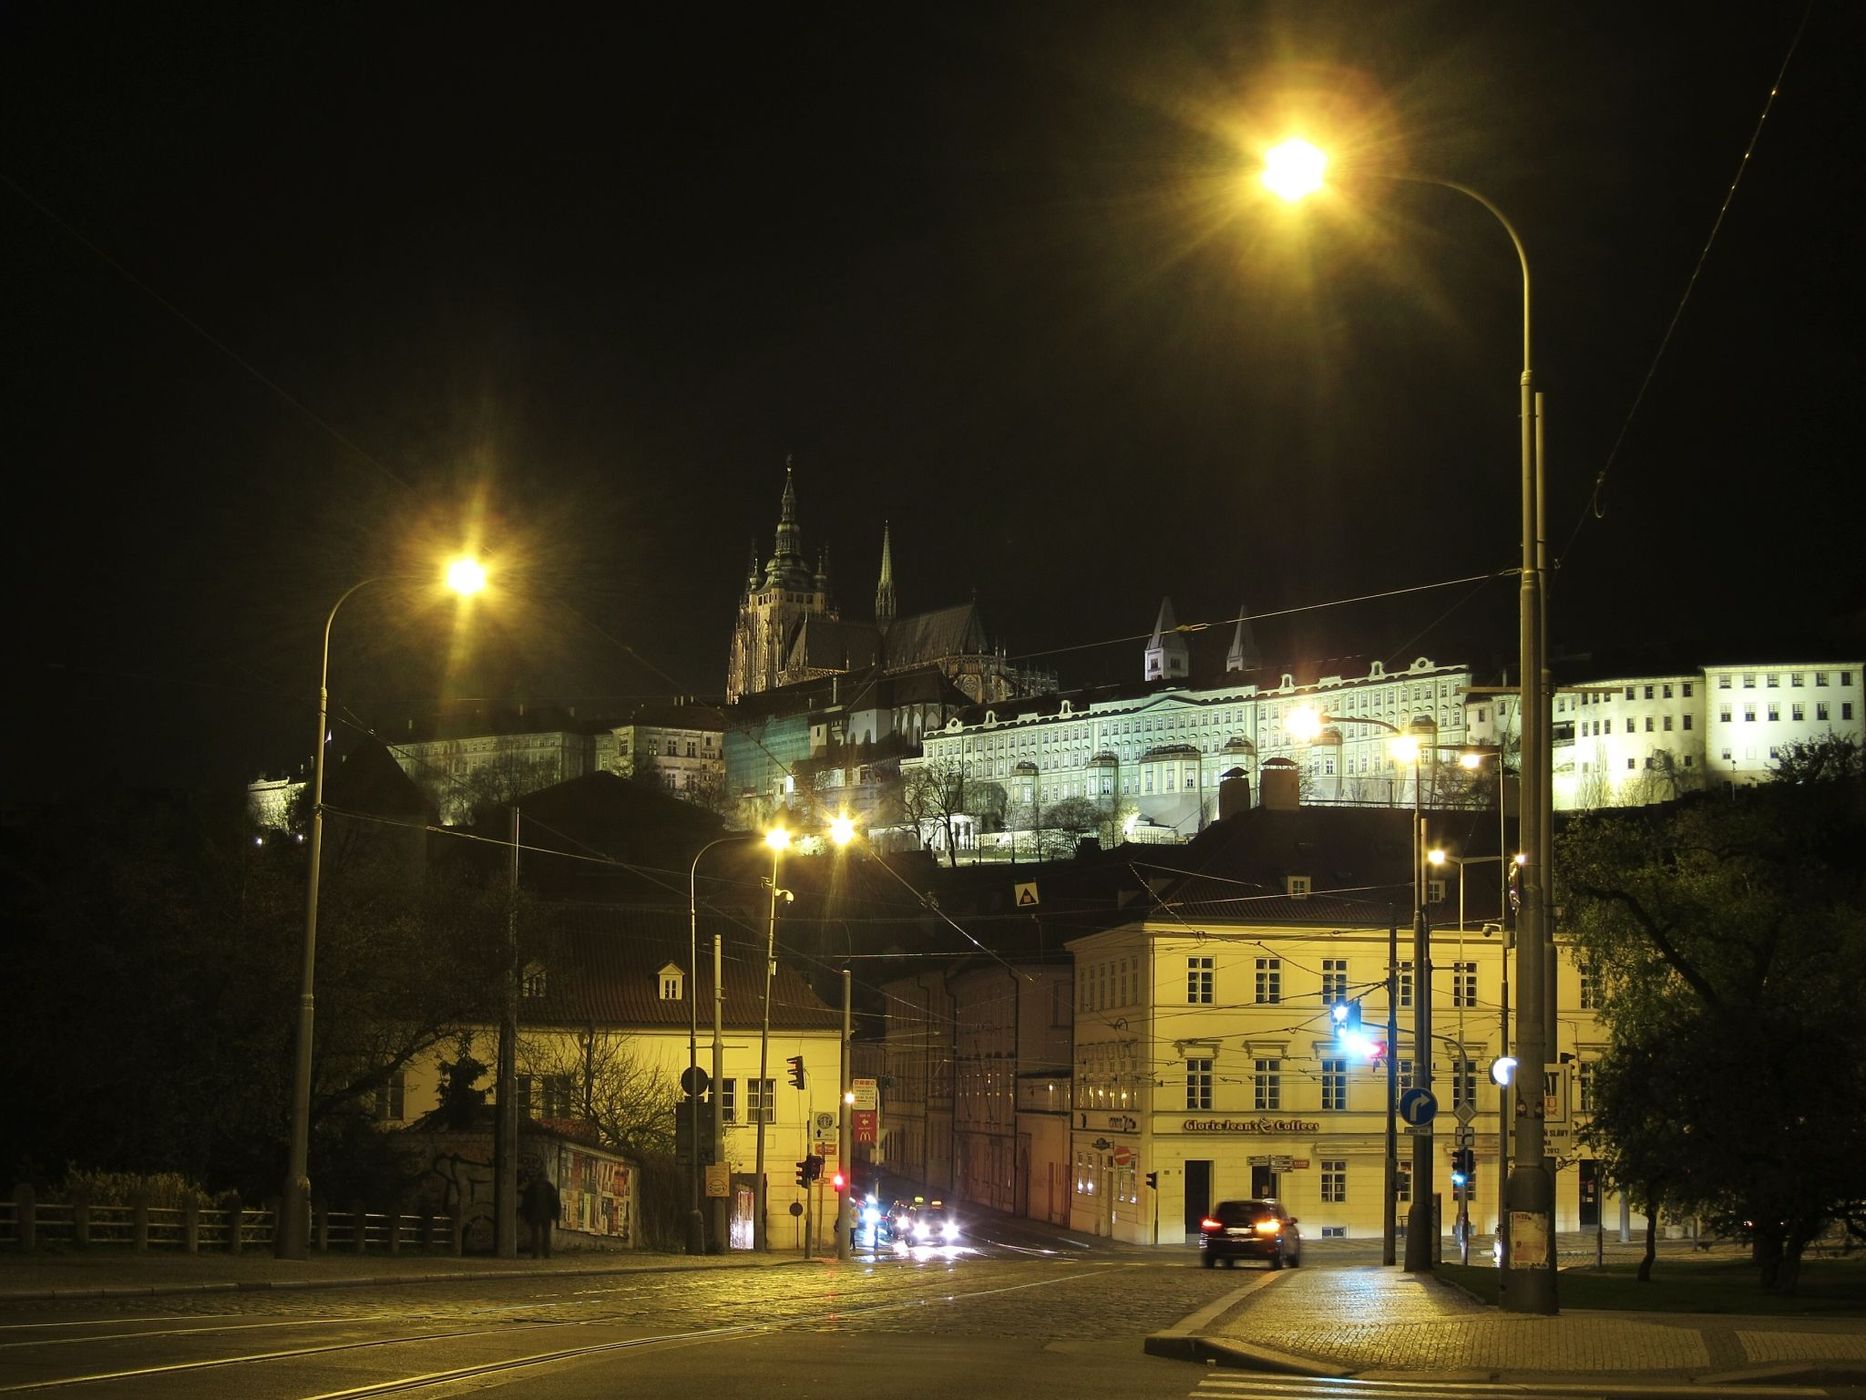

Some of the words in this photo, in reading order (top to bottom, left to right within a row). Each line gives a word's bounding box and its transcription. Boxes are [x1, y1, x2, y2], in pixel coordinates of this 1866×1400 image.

[1184, 1119, 1222, 1131] Gloria
[1225, 1119, 1259, 1131] Jean's
[1275, 1119, 1320, 1131] Coffees
